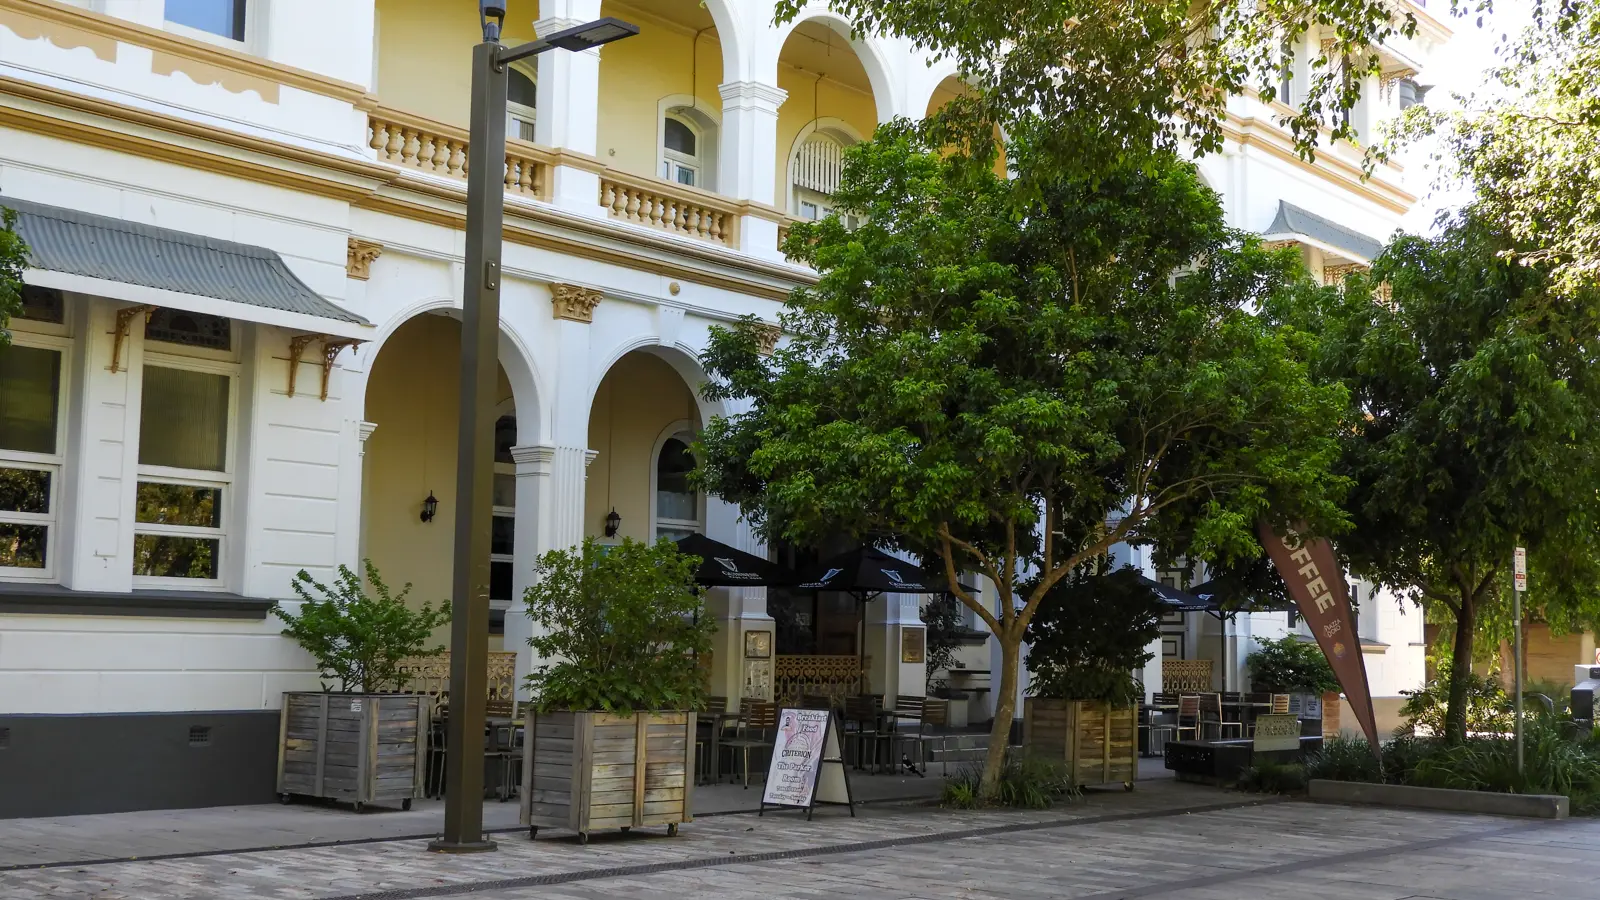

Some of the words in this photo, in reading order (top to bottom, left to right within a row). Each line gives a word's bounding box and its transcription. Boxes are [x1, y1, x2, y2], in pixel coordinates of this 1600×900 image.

[1280, 516, 1336, 614] OFFEE
[797, 713, 827, 722] Breakfast
[802, 724, 818, 732] Food
[781, 750, 812, 758] CRITERION
[777, 762, 789, 770] The
[790, 762, 811, 771] Parker
[782, 774, 801, 783] Room
